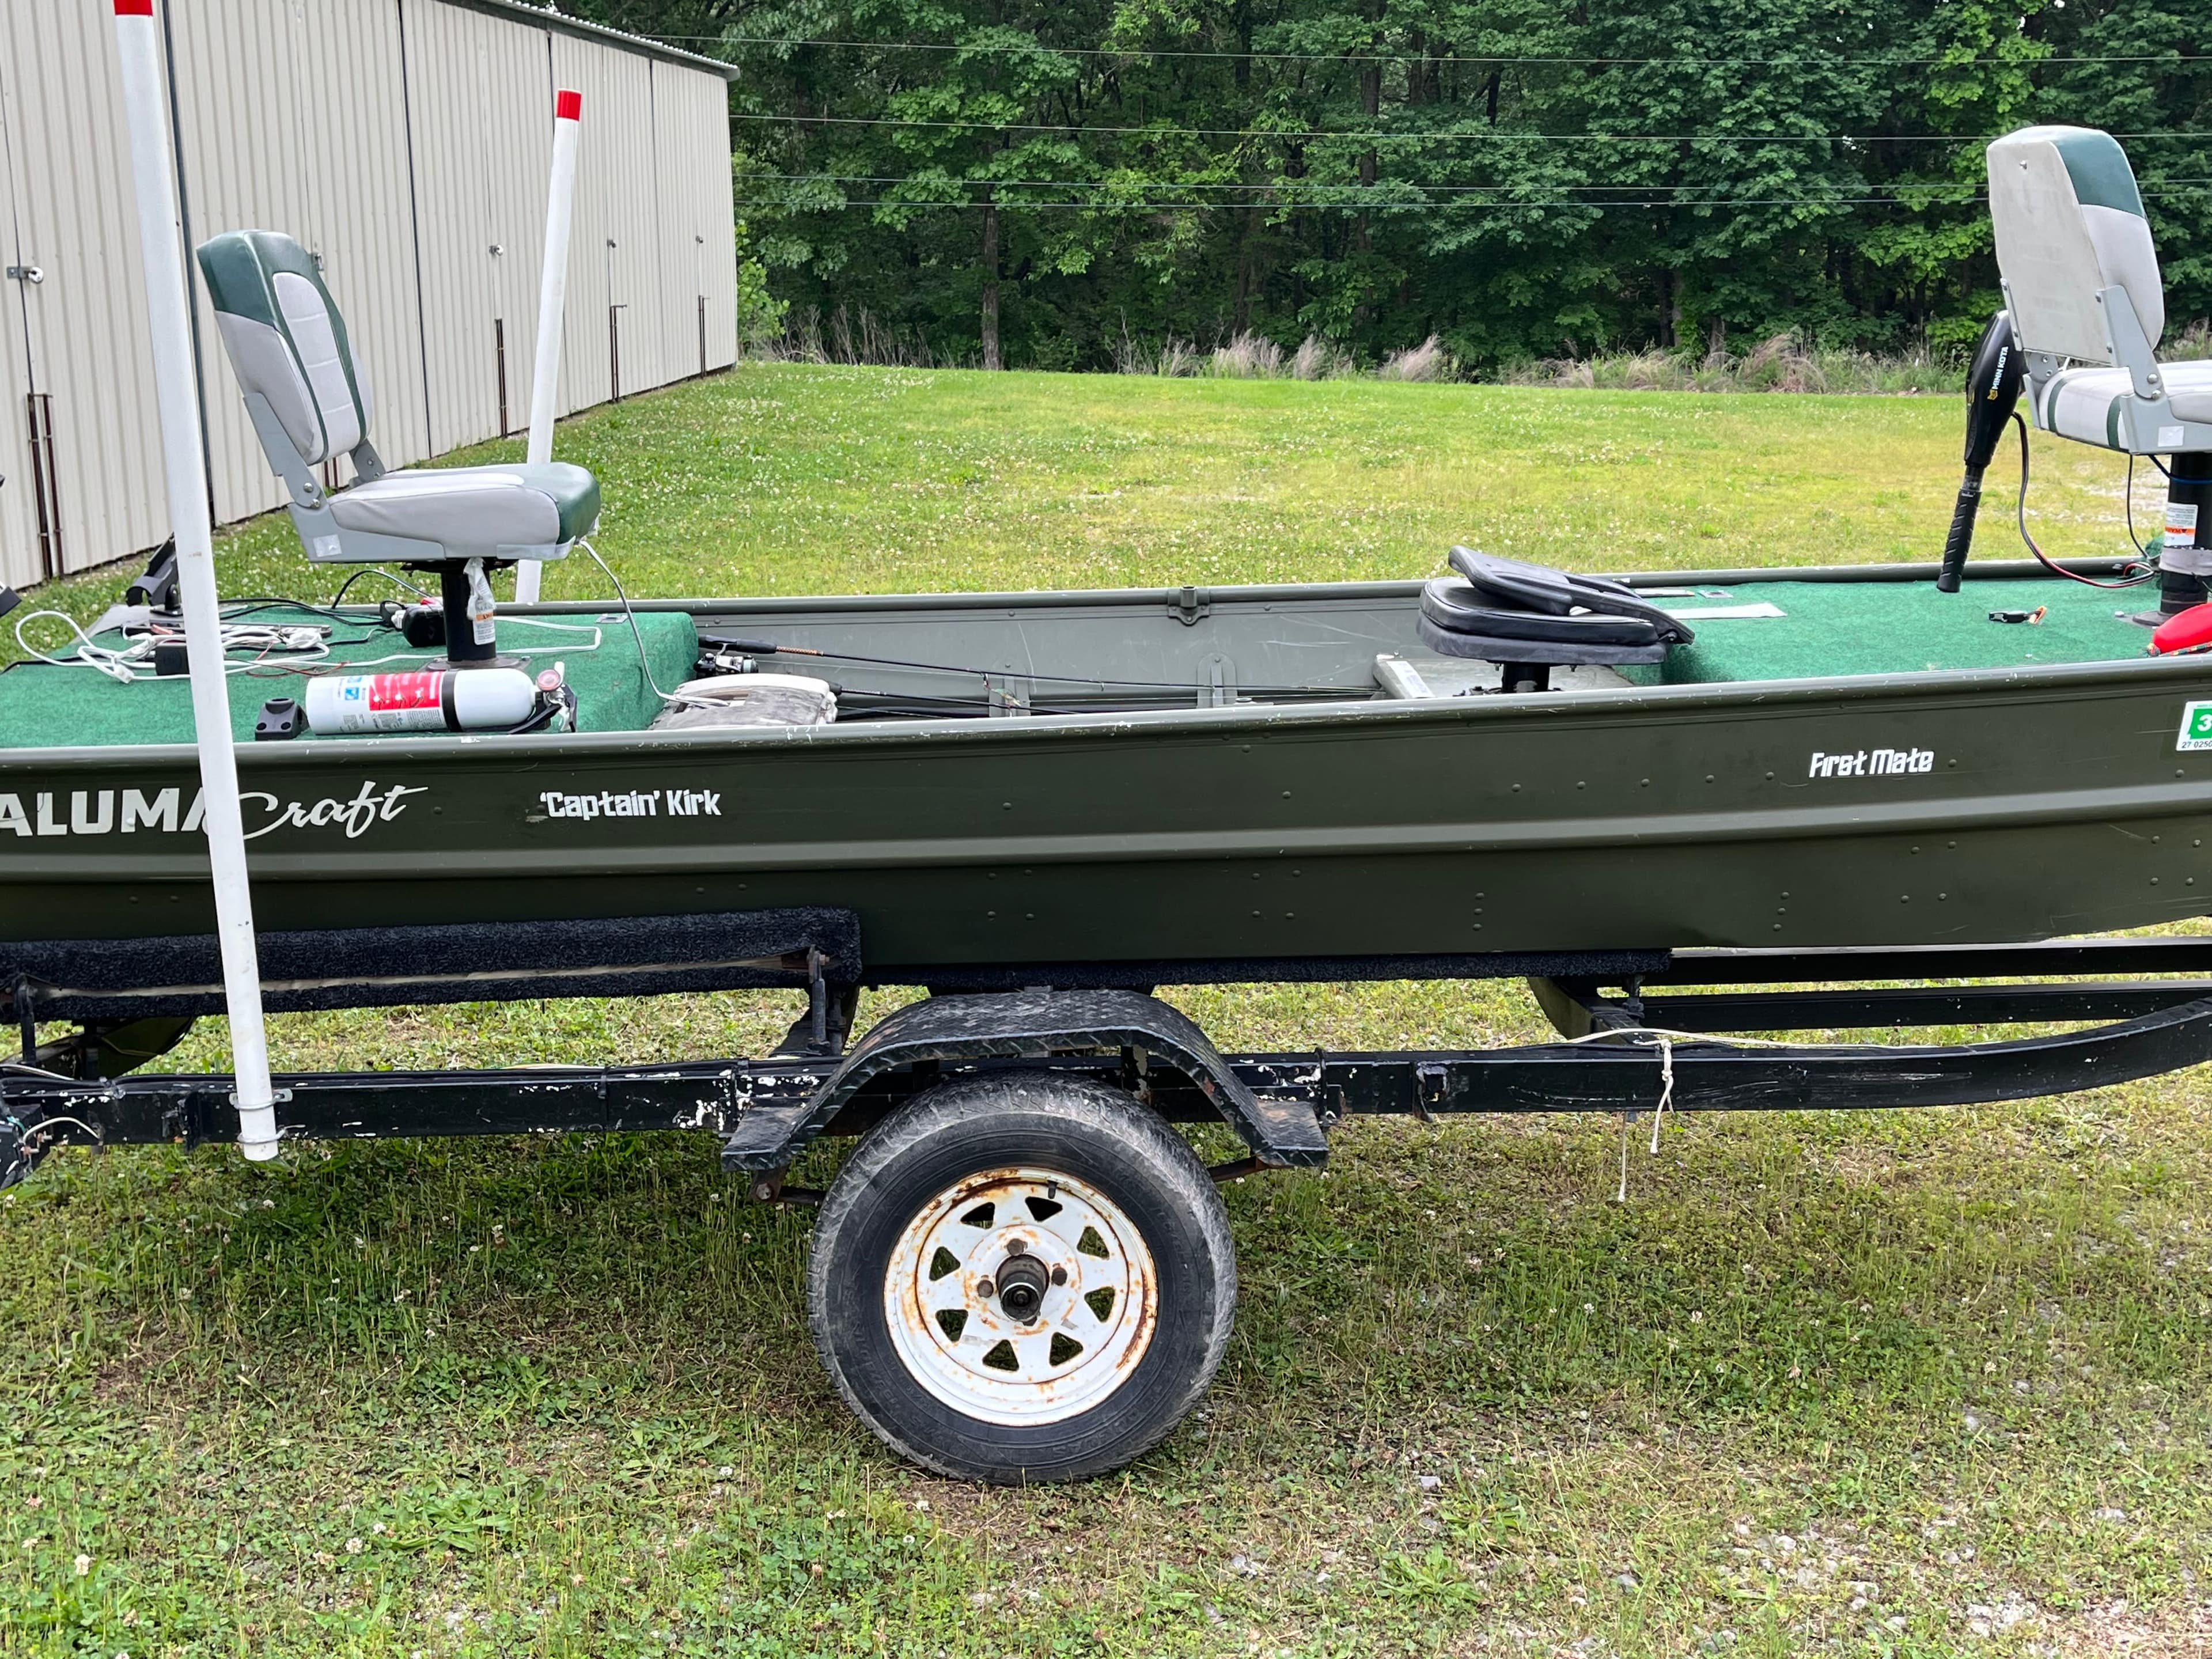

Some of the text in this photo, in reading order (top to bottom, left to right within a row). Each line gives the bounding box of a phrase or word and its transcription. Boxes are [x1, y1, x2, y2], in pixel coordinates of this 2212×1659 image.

[1992, 347, 2009, 389] MINN KOTA
[2198, 714, 2212, 732] 3
[1809, 748, 1934, 778] First Mate
[666, 790, 722, 816] Kirk
